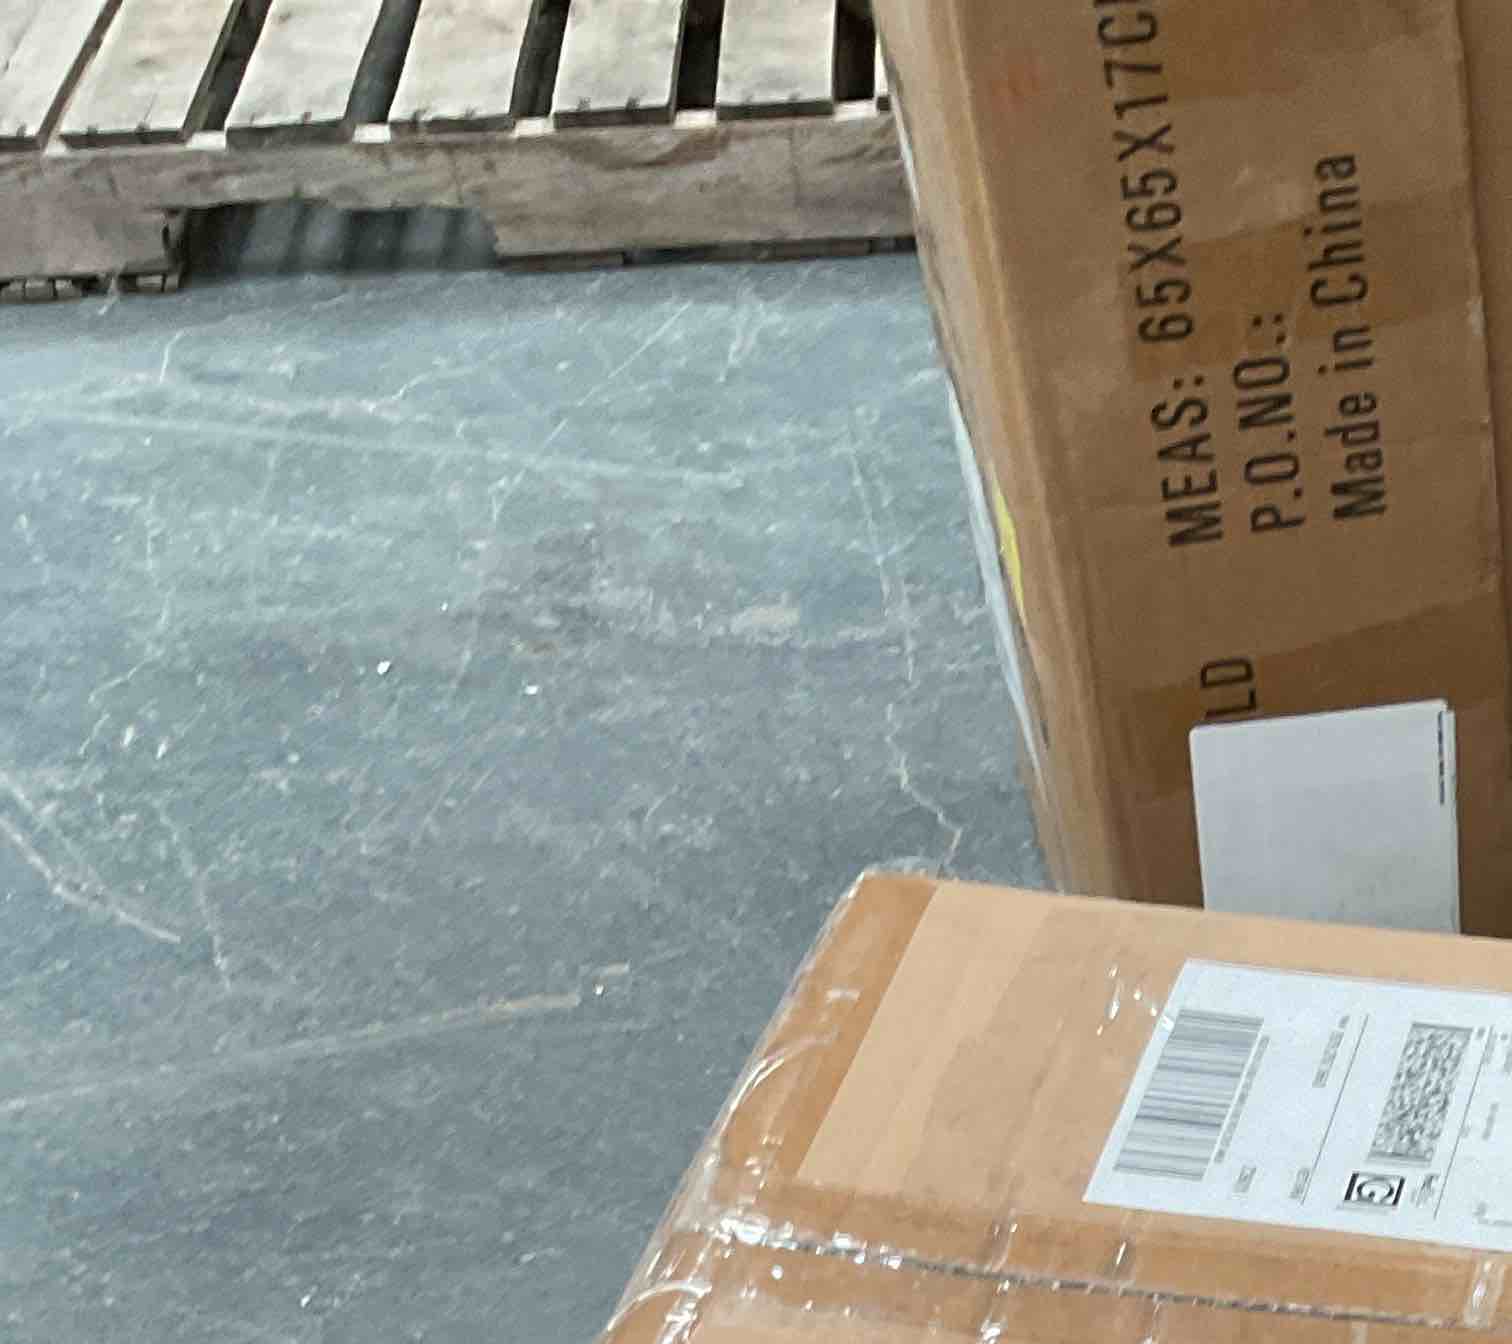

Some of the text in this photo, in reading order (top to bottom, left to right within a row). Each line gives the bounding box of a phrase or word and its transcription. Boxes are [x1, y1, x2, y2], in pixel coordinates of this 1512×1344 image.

[1094, 0, 1223, 546] MEAS: 65X65X17C
[1303, 154, 1387, 520] Made in China
